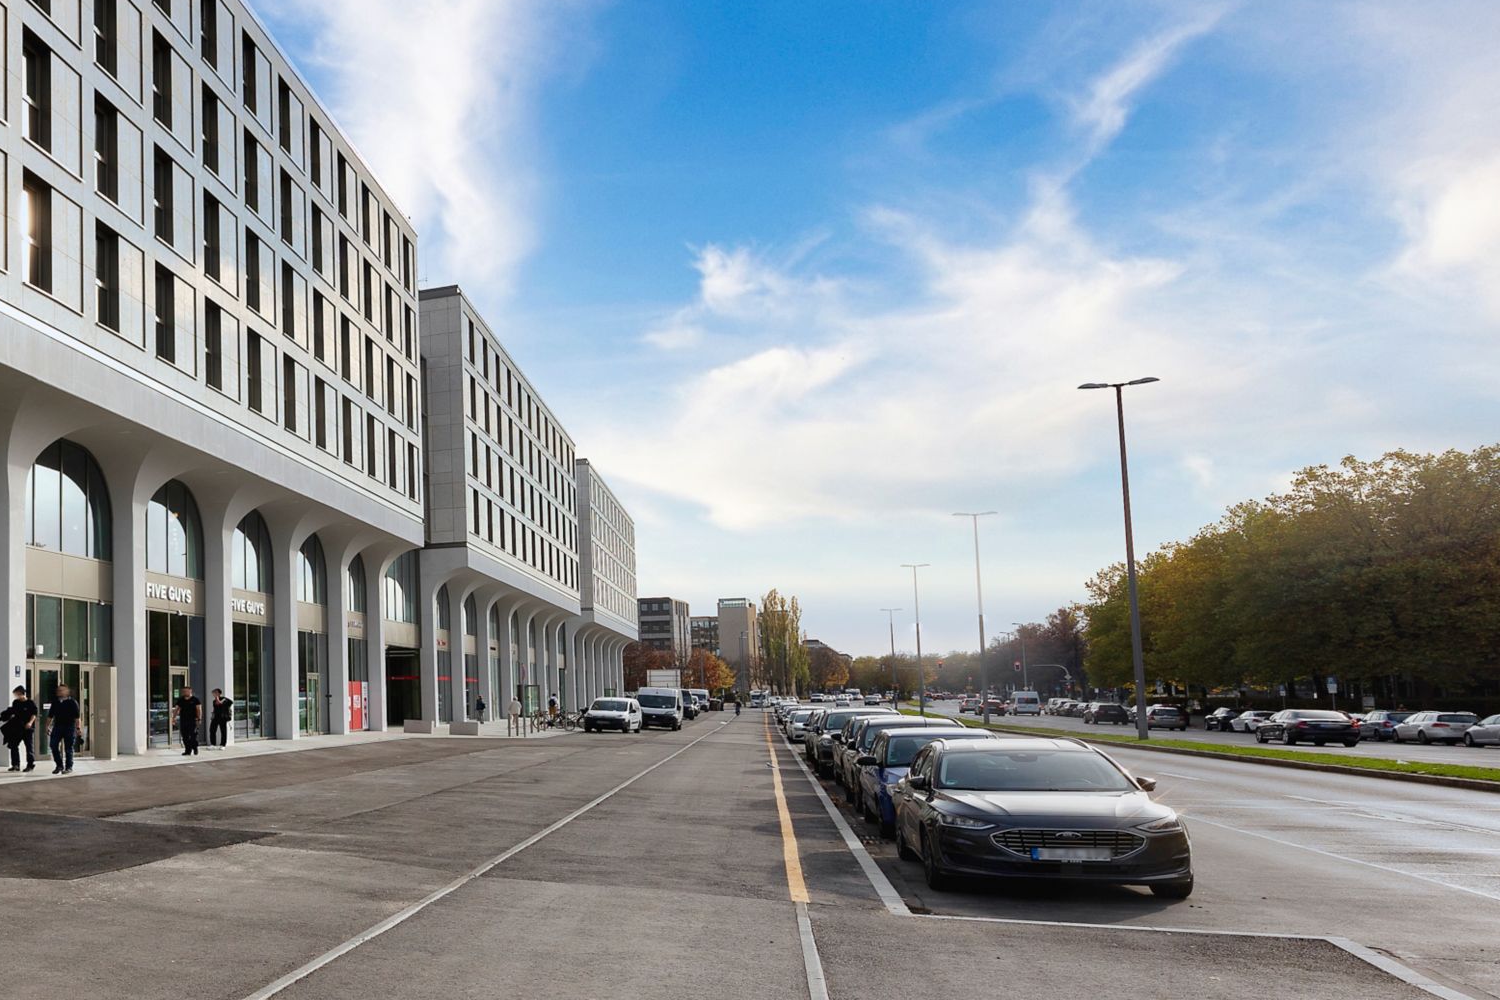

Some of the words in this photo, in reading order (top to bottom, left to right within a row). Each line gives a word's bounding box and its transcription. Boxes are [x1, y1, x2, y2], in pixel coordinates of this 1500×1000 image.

[146, 582, 167, 600] FIVE
[168, 588, 192, 604] GUYS
[231, 598, 247, 613] FIVE
[247, 600, 265, 616] GUYS
